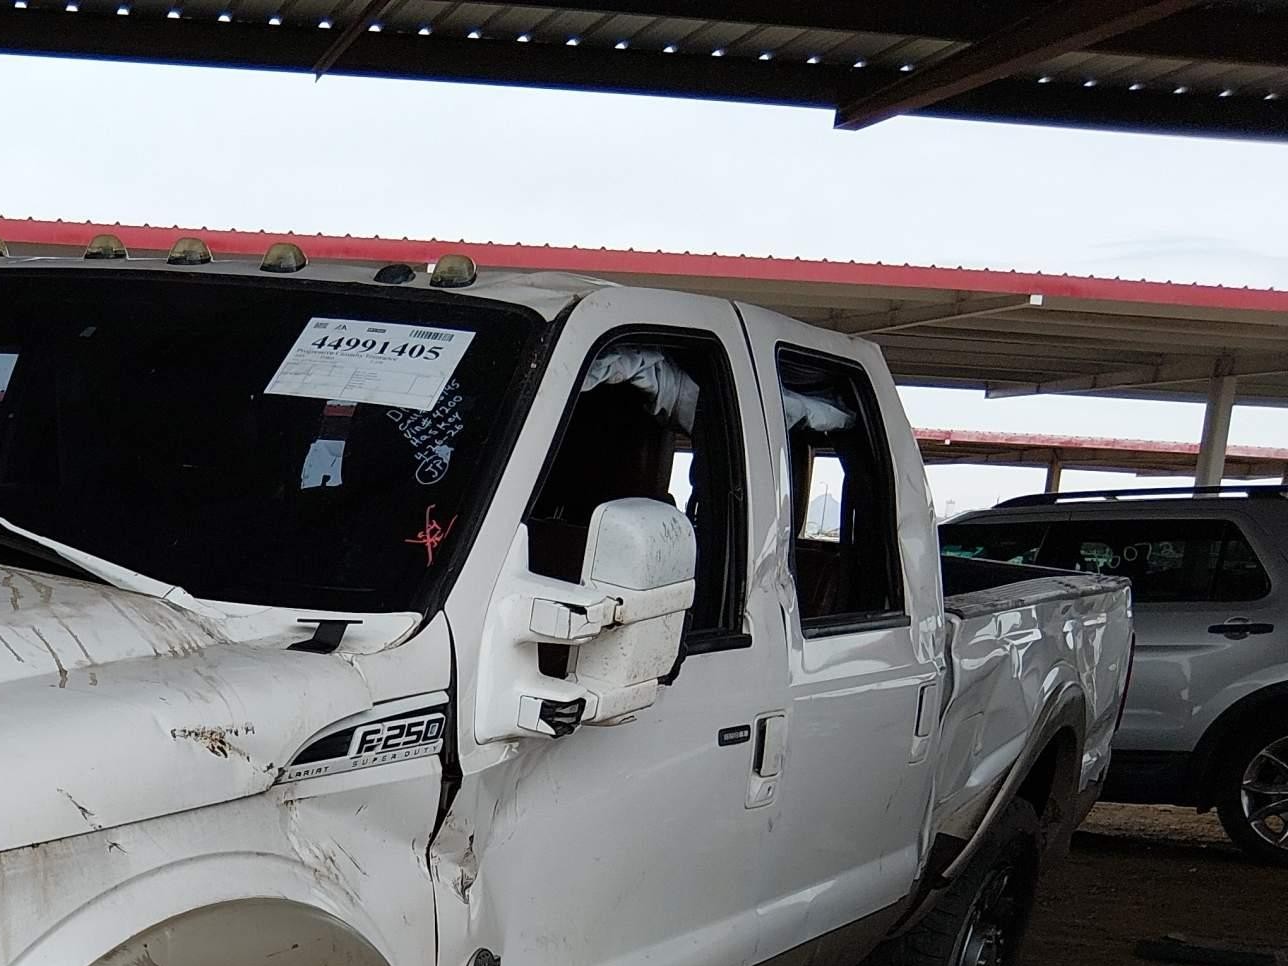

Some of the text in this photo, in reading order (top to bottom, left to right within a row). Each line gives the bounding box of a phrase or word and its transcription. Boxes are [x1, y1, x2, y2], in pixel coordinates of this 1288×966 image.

[312, 335, 444, 361] 44991405
[432, 395, 463, 418] 4200
[414, 424, 464, 463] 4-26-26
[355, 717, 444, 755] F-250
[287, 745, 438, 779] LARIAT SUPER DUTY
